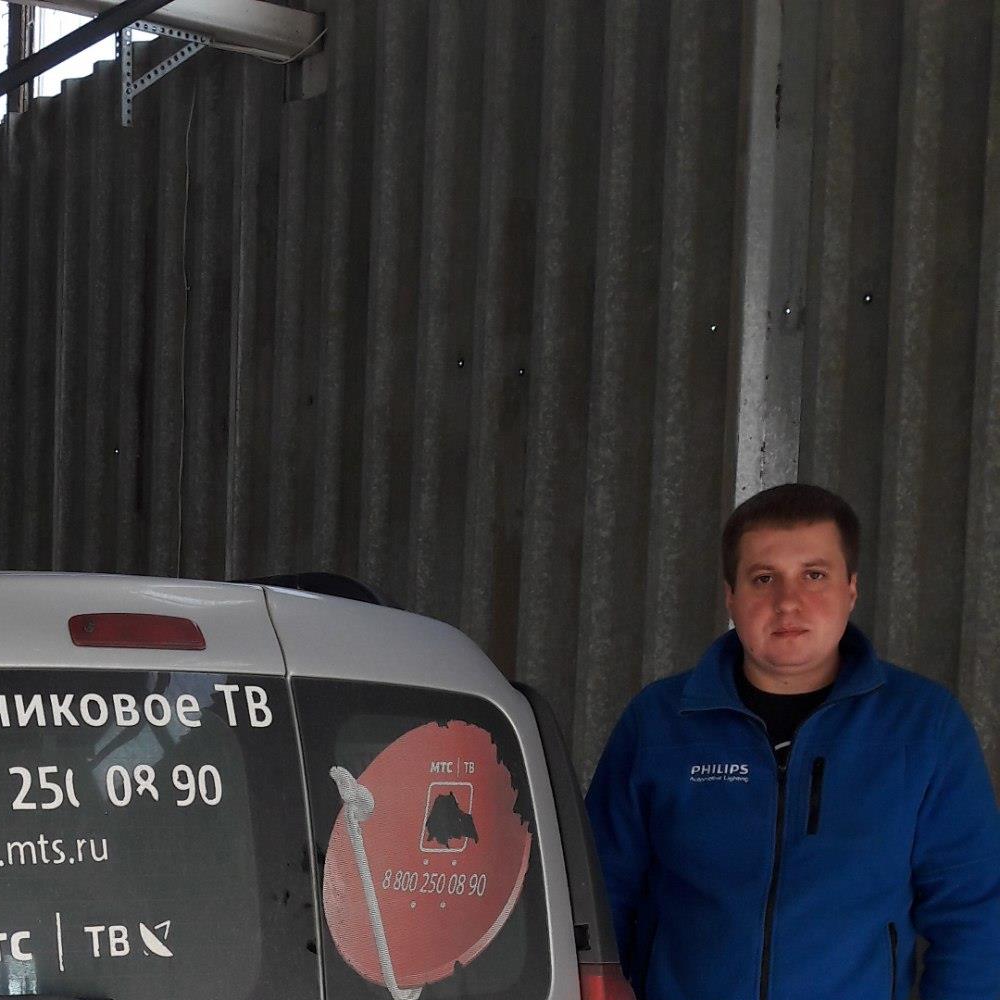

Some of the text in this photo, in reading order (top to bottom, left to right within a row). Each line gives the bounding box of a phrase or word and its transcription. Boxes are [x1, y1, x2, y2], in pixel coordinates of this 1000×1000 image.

[215, 684, 274, 729] ТВ
[430, 761, 475, 774] МТС ТВ
[691, 763, 749, 775] PHILIPS
[106, 764, 159, 807] 08
[172, 763, 223, 807] 90
[382, 868, 487, 897] 8 800 250 08 90
[84, 925, 130, 958] ТВ
